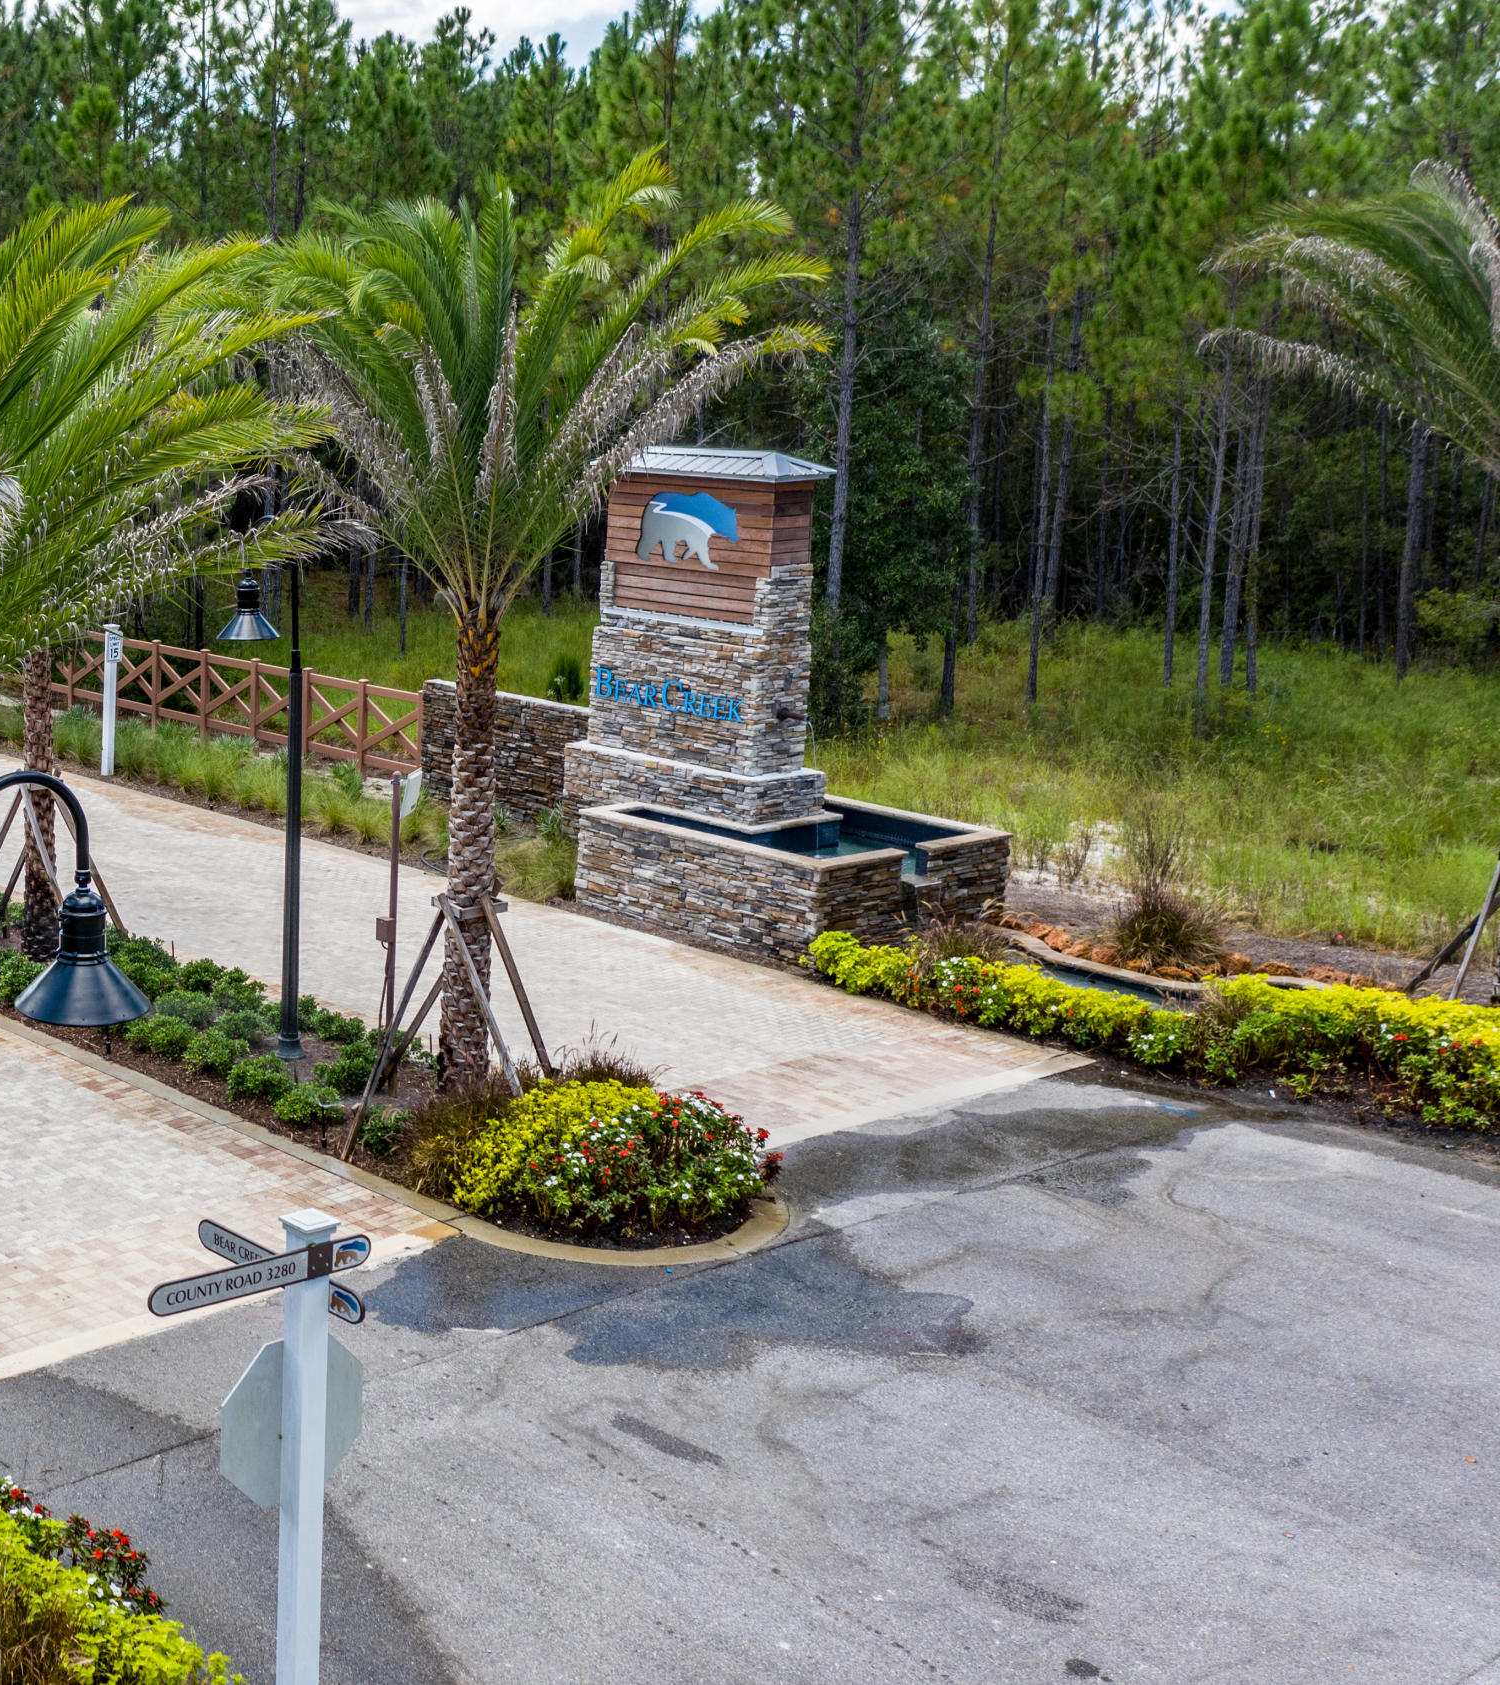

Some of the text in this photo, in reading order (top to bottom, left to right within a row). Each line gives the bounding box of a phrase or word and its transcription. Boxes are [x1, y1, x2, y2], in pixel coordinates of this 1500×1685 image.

[110, 647, 119, 659] 15
[213, 1233, 263, 1262] BEAR CREE
[166, 1262, 296, 1306] COUNTY ROAD 3280
